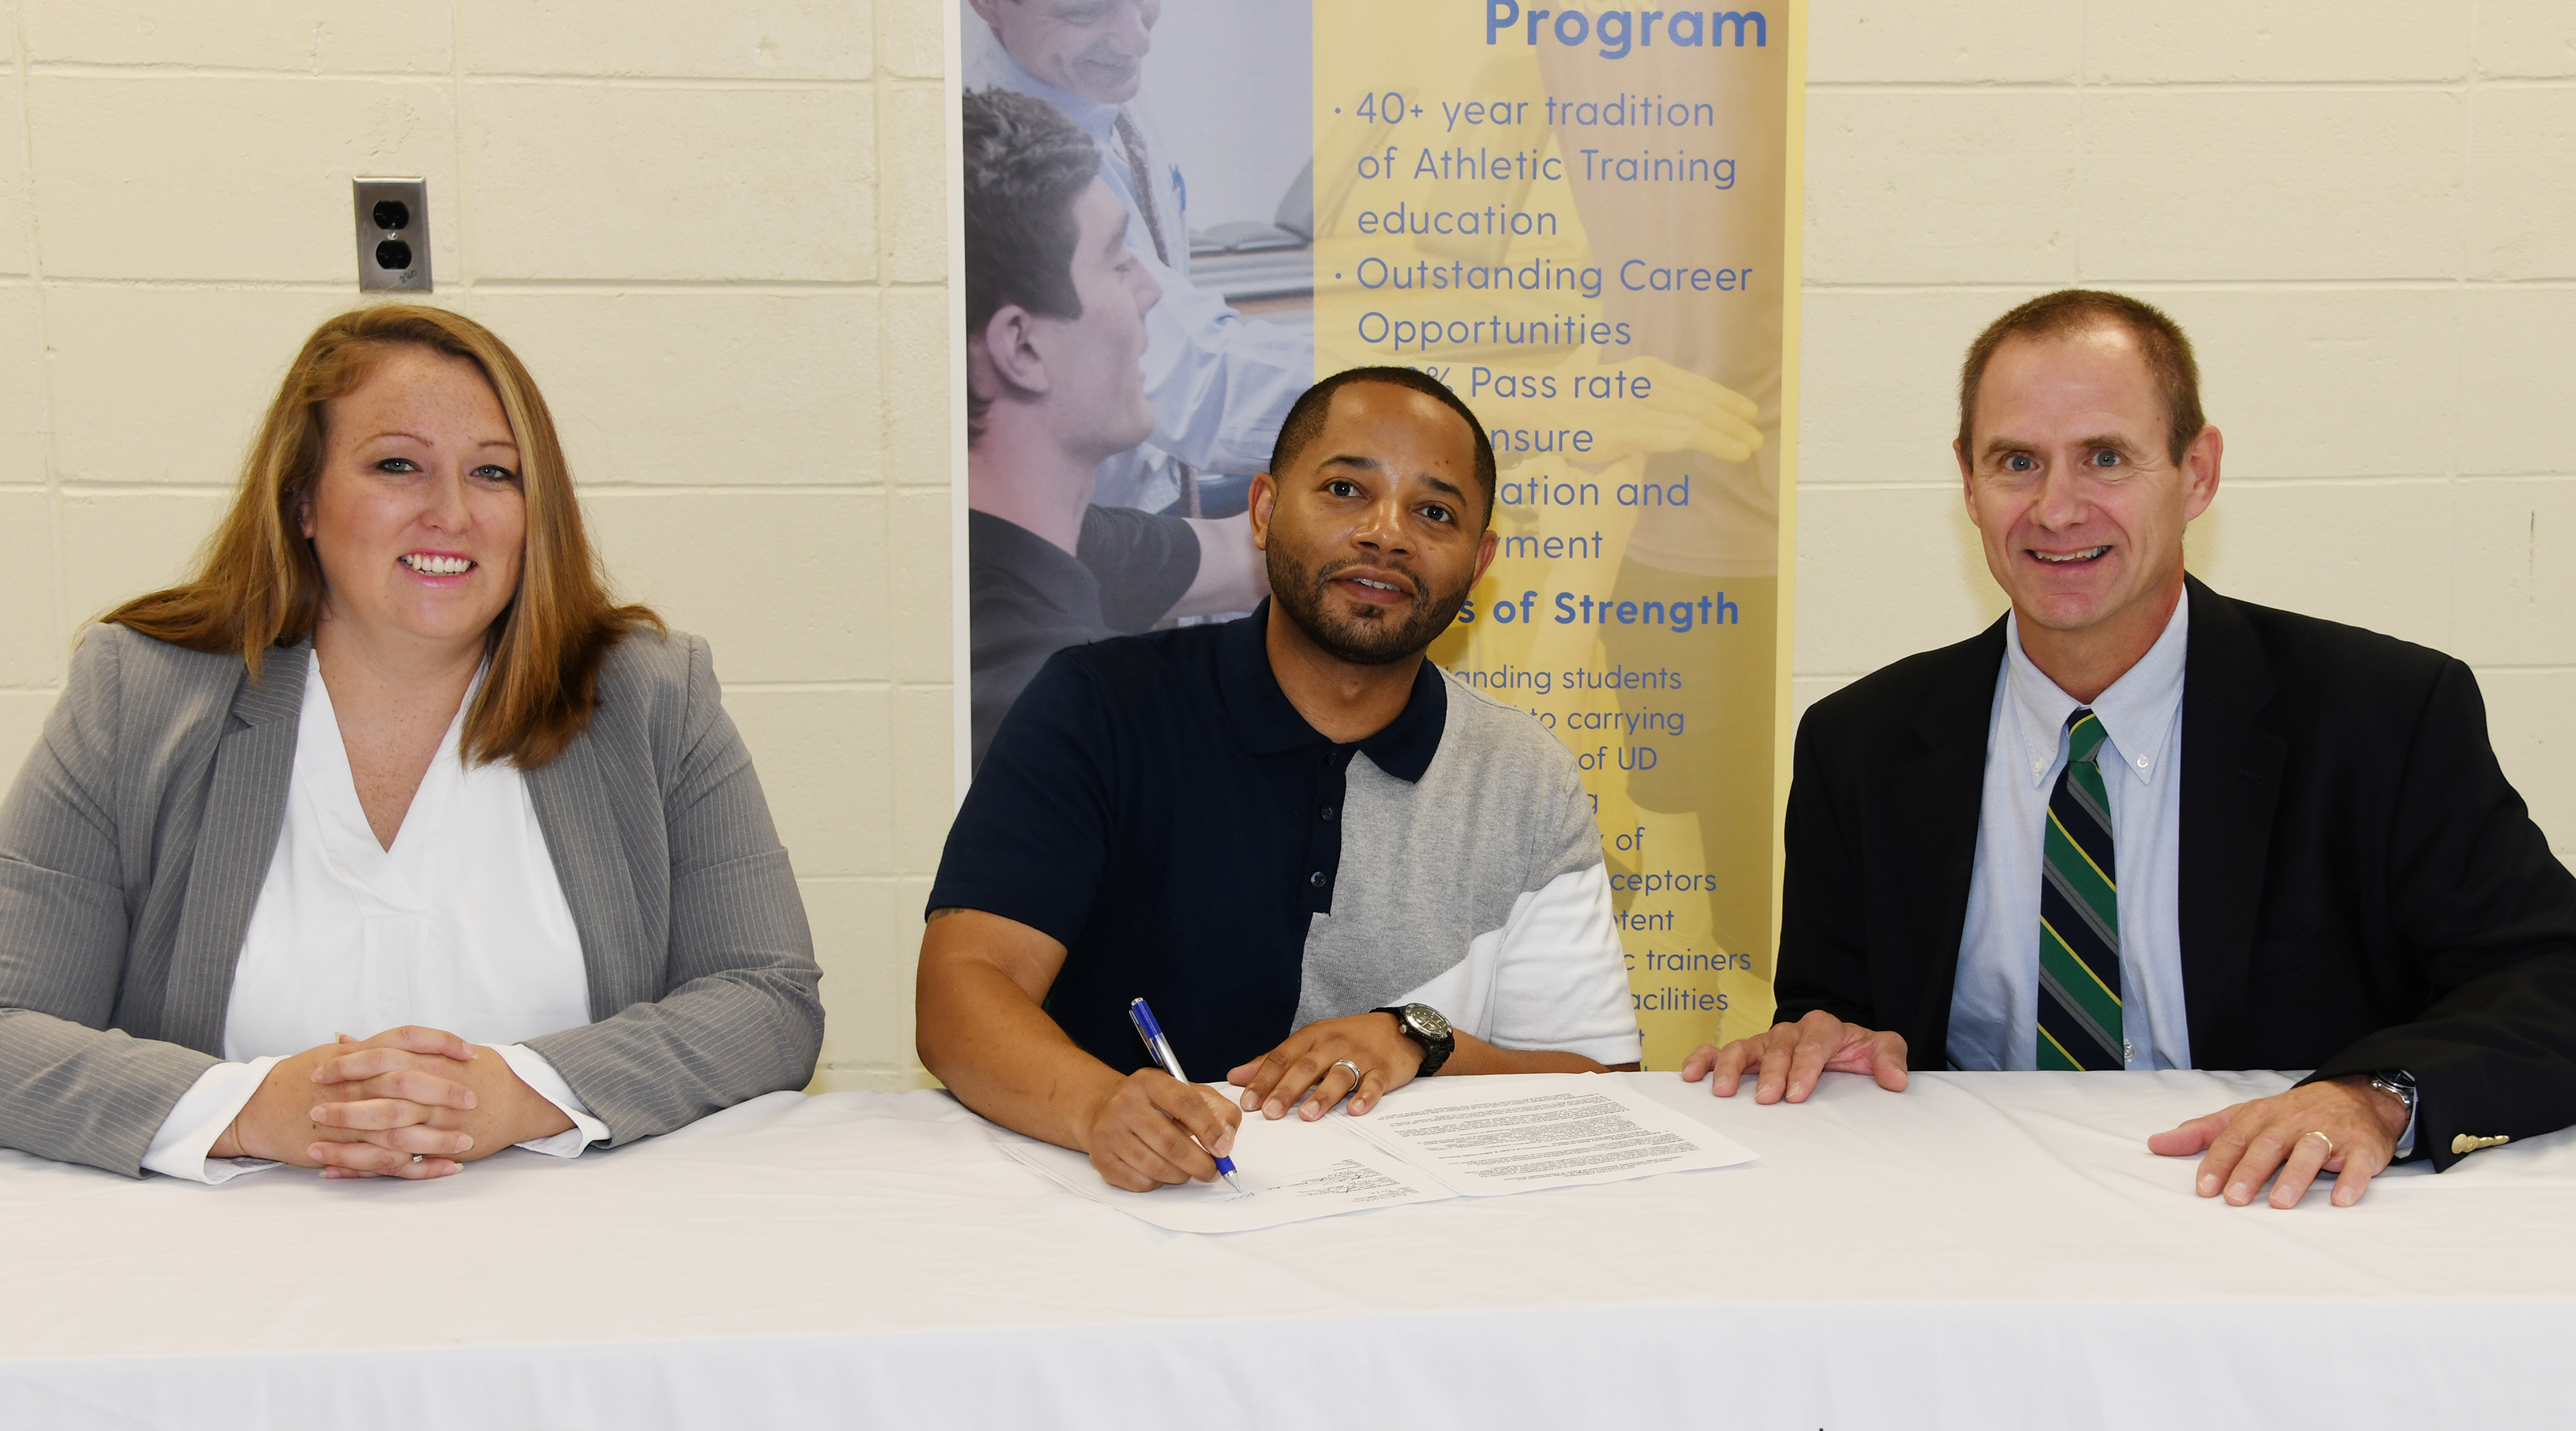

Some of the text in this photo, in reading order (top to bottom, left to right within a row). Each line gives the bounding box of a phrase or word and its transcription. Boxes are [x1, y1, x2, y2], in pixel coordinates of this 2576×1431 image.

[1486, 0, 1767, 59] Program
[1356, 92, 1713, 132] 40+ year tradition
[1357, 146, 1735, 189] of Athletic Training
[1358, 201, 1556, 235] education
[1357, 257, 1753, 298] Outstanding Career
[1358, 311, 1631, 350] Opportunities
[1472, 366, 1556, 398] Pass
[1574, 370, 1651, 399] rate
[1490, 429, 1593, 452] nsure
[1493, 474, 1690, 506] ation and
[1497, 531, 1603, 558] ment
[1493, 590, 1537, 624] of
[1555, 591, 1739, 633] Strength
[1446, 665, 1682, 695] anding students
[1568, 706, 1684, 736] carrying
[1579, 746, 1657, 770] of UD
[1616, 827, 1645, 850] of
[1611, 871, 1717, 896] ceptors
[1615, 910, 1673, 931] tent
[1647, 950, 1751, 971] trainers
[1631, 987, 1728, 1010] acilities
